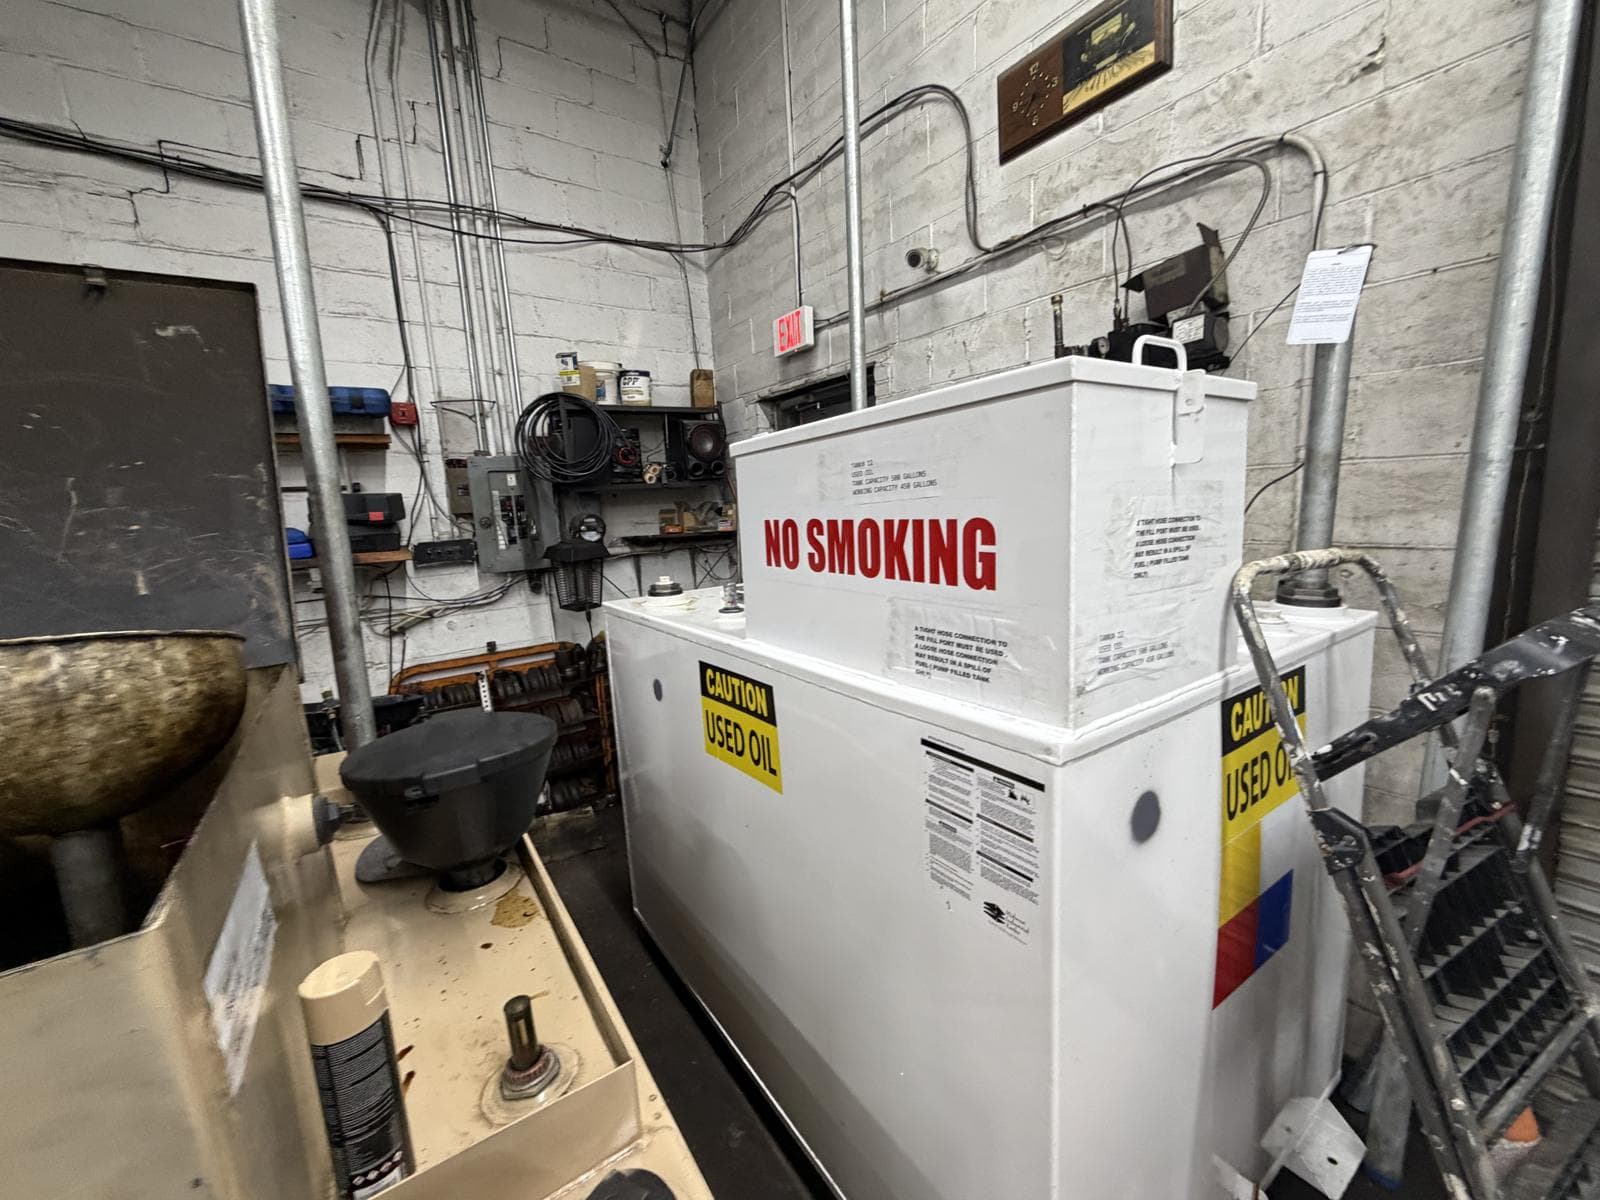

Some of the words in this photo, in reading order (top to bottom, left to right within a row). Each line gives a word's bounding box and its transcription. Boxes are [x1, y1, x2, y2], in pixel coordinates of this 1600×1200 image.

[778, 310, 801, 352] EXIT
[864, 476, 888, 484] CAPACITY
[902, 470, 926, 480] GALLONS
[874, 484, 898, 492] CAPACITY
[912, 478, 938, 488] GALLONS
[1168, 515, 1195, 523] CONNECTION
[764, 518, 800, 570] NO
[806, 518, 996, 591] SMOKING
[937, 630, 953, 638] HOSE
[954, 633, 996, 645] CONNECTION
[956, 642, 973, 651] MUST
[920, 644, 937, 652] LOOSE
[956, 652, 998, 665] CONNECTION
[927, 654, 948, 663] RESULT
[964, 662, 981, 672] SPILL
[933, 664, 949, 672] PUMP
[950, 668, 971, 678] FILLED
[972, 673, 990, 683] TANK
[706, 668, 768, 717] CAUTION
[706, 710, 745, 758] USED
[749, 730, 778, 776] OIL
[1226, 750, 1270, 821] USED
